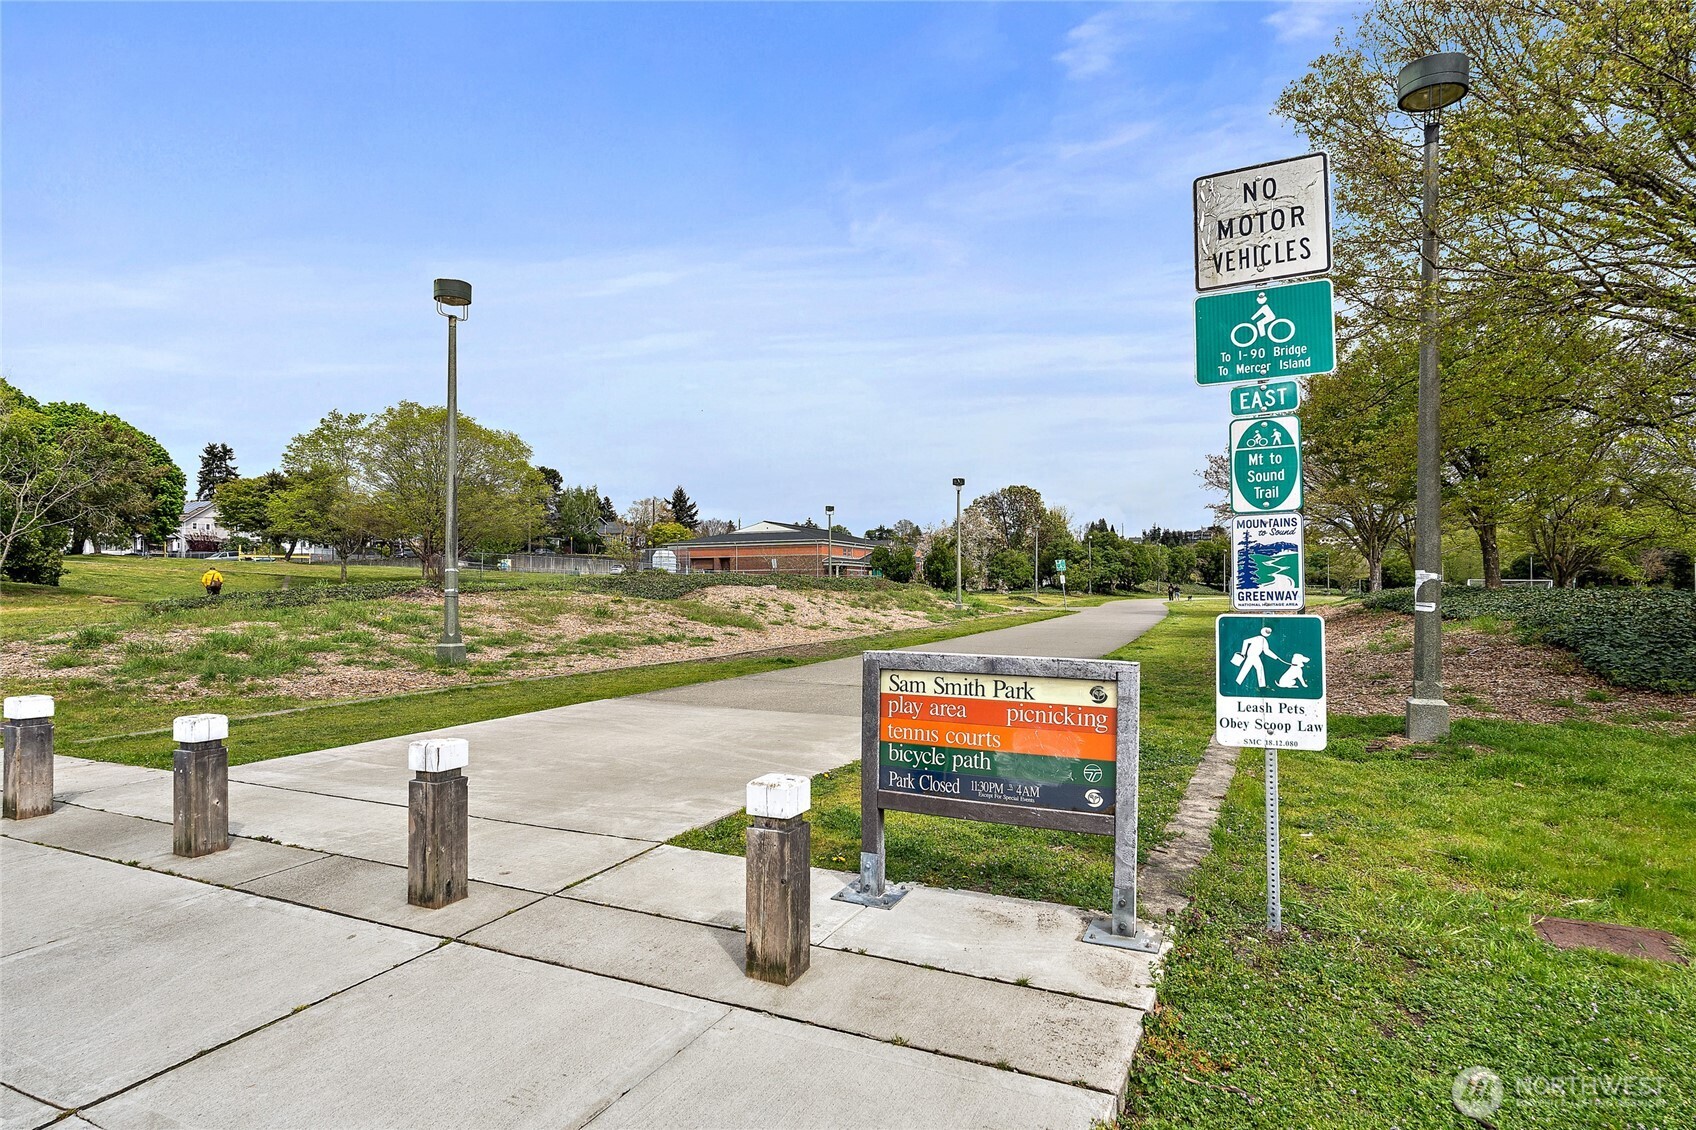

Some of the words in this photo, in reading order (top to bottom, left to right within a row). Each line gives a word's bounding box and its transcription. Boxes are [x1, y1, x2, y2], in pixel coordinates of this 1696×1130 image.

[1243, 177, 1277, 204] NO
[1217, 206, 1305, 241] MOTOR
[1212, 237, 1311, 274] VEHICLES
[1220, 352, 1231, 362] To
[1238, 348, 1266, 361] I-90
[1273, 345, 1307, 358] Bridge
[1218, 366, 1229, 376] To
[1236, 363, 1271, 374] Mercer
[1279, 356, 1311, 370] Island
[1239, 388, 1287, 410] EAST
[1248, 453, 1264, 466] Mt
[1269, 453, 1282, 465] to
[1247, 469, 1285, 482] Sound
[1254, 486, 1279, 499] Trail
[1236, 517, 1298, 529] MOUNTAINS
[1258, 529, 1267, 537] to
[1269, 527, 1296, 536] Sound
[1237, 590, 1298, 601] GREENWAY
[889, 674, 926, 694] Sam
[933, 676, 985, 698] Smith
[992, 680, 1036, 701] Park
[887, 696, 923, 719] play
[930, 703, 967, 718] area
[1006, 703, 1108, 734] picnicking
[1237, 701, 1273, 714] Leash
[1278, 702, 1305, 714] Pets
[1219, 717, 1249, 731] Obey
[1254, 718, 1291, 733] Scoop
[1298, 720, 1324, 732] Law
[887, 723, 939, 742] tennis
[945, 730, 1001, 748] courts
[1243, 738, 1262, 746] SMC
[888, 743, 946, 768] bicycle
[951, 751, 992, 772] path
[888, 771, 915, 790] Park
[919, 774, 960, 795] Closed
[971, 780, 1004, 794] 11:30PM
[1016, 784, 1040, 798] 4AM
[978, 791, 993, 799] Except
[1003, 794, 1019, 802] Special
